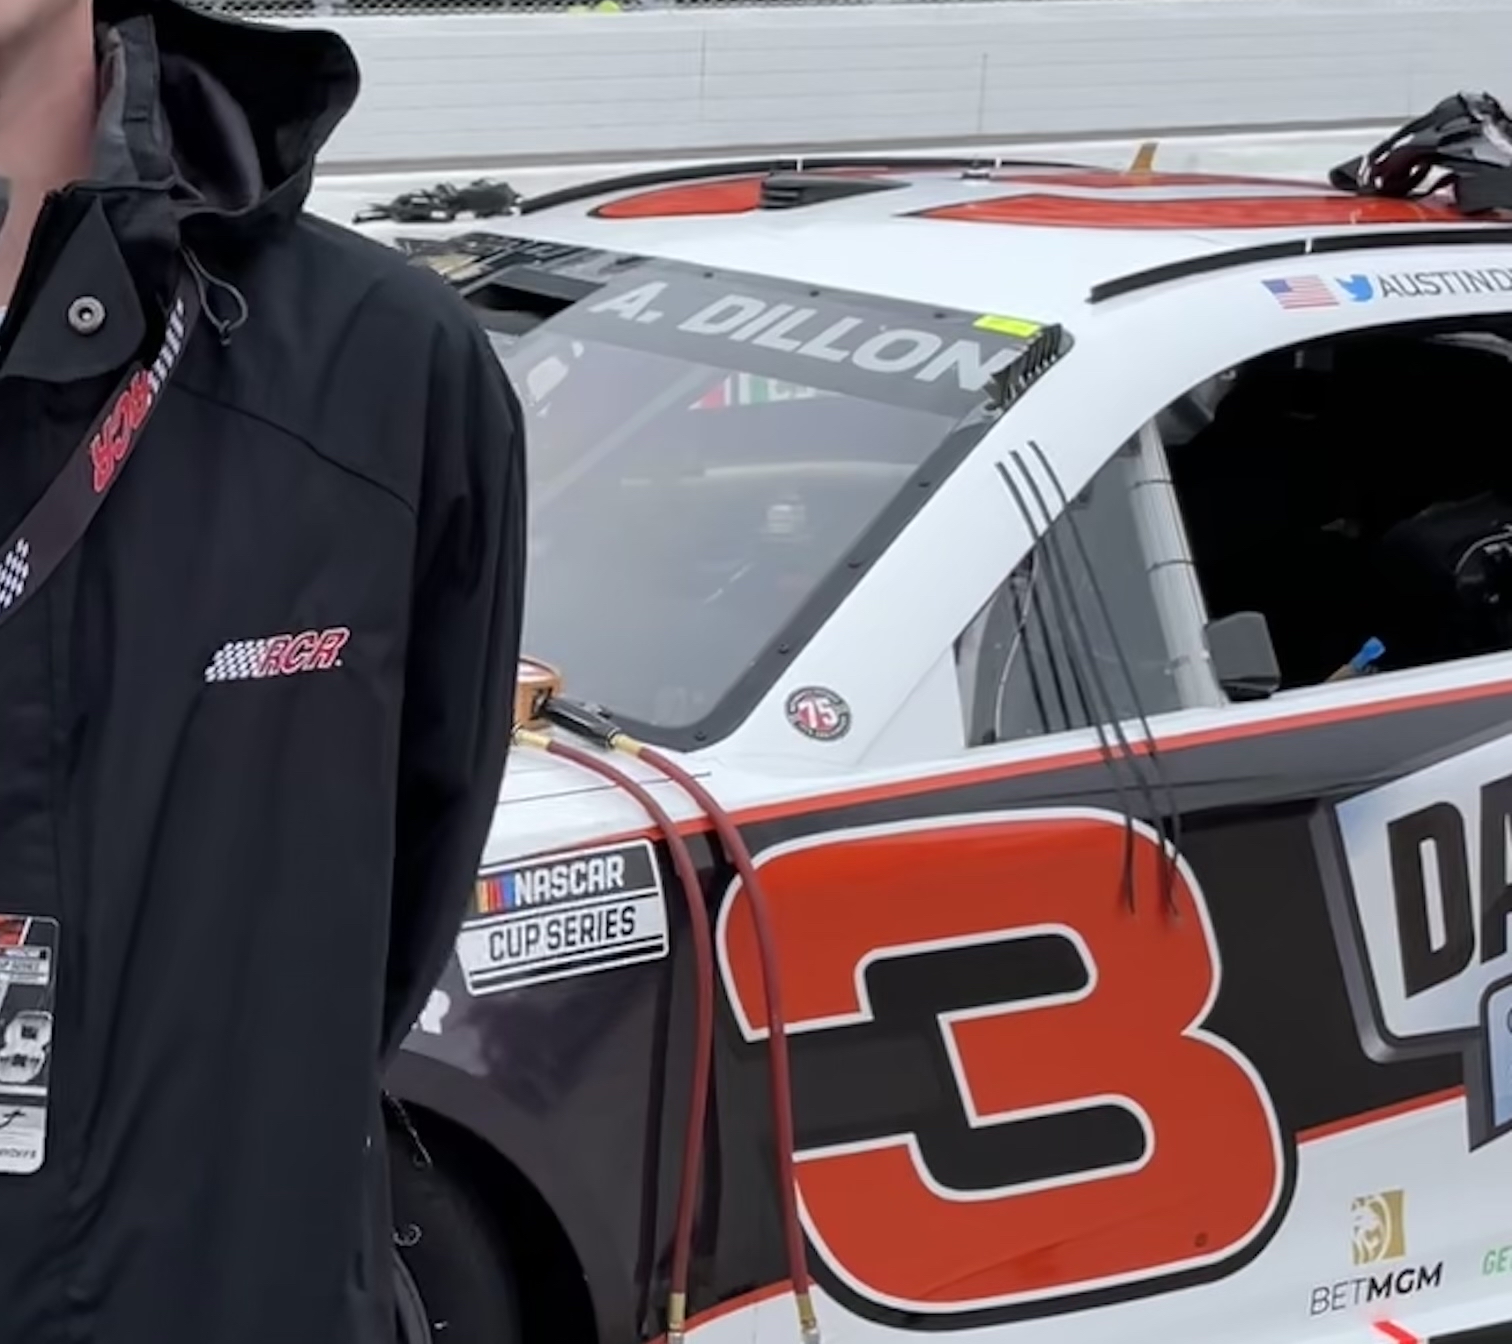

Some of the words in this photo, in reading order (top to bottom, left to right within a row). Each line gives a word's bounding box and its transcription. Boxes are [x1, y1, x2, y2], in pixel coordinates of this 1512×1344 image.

[1379, 267, 1512, 298] AUSTIND
[588, 280, 668, 325] A.
[676, 293, 1022, 392] DILLON
[250, 626, 351, 675] RCR
[797, 698, 839, 729] 75
[514, 854, 625, 907] NASCAR
[489, 923, 540, 962] CUP
[546, 905, 636, 951] SERIES
[717, 809, 1285, 1314] 3
[1310, 1260, 1444, 1317] BETMGM
